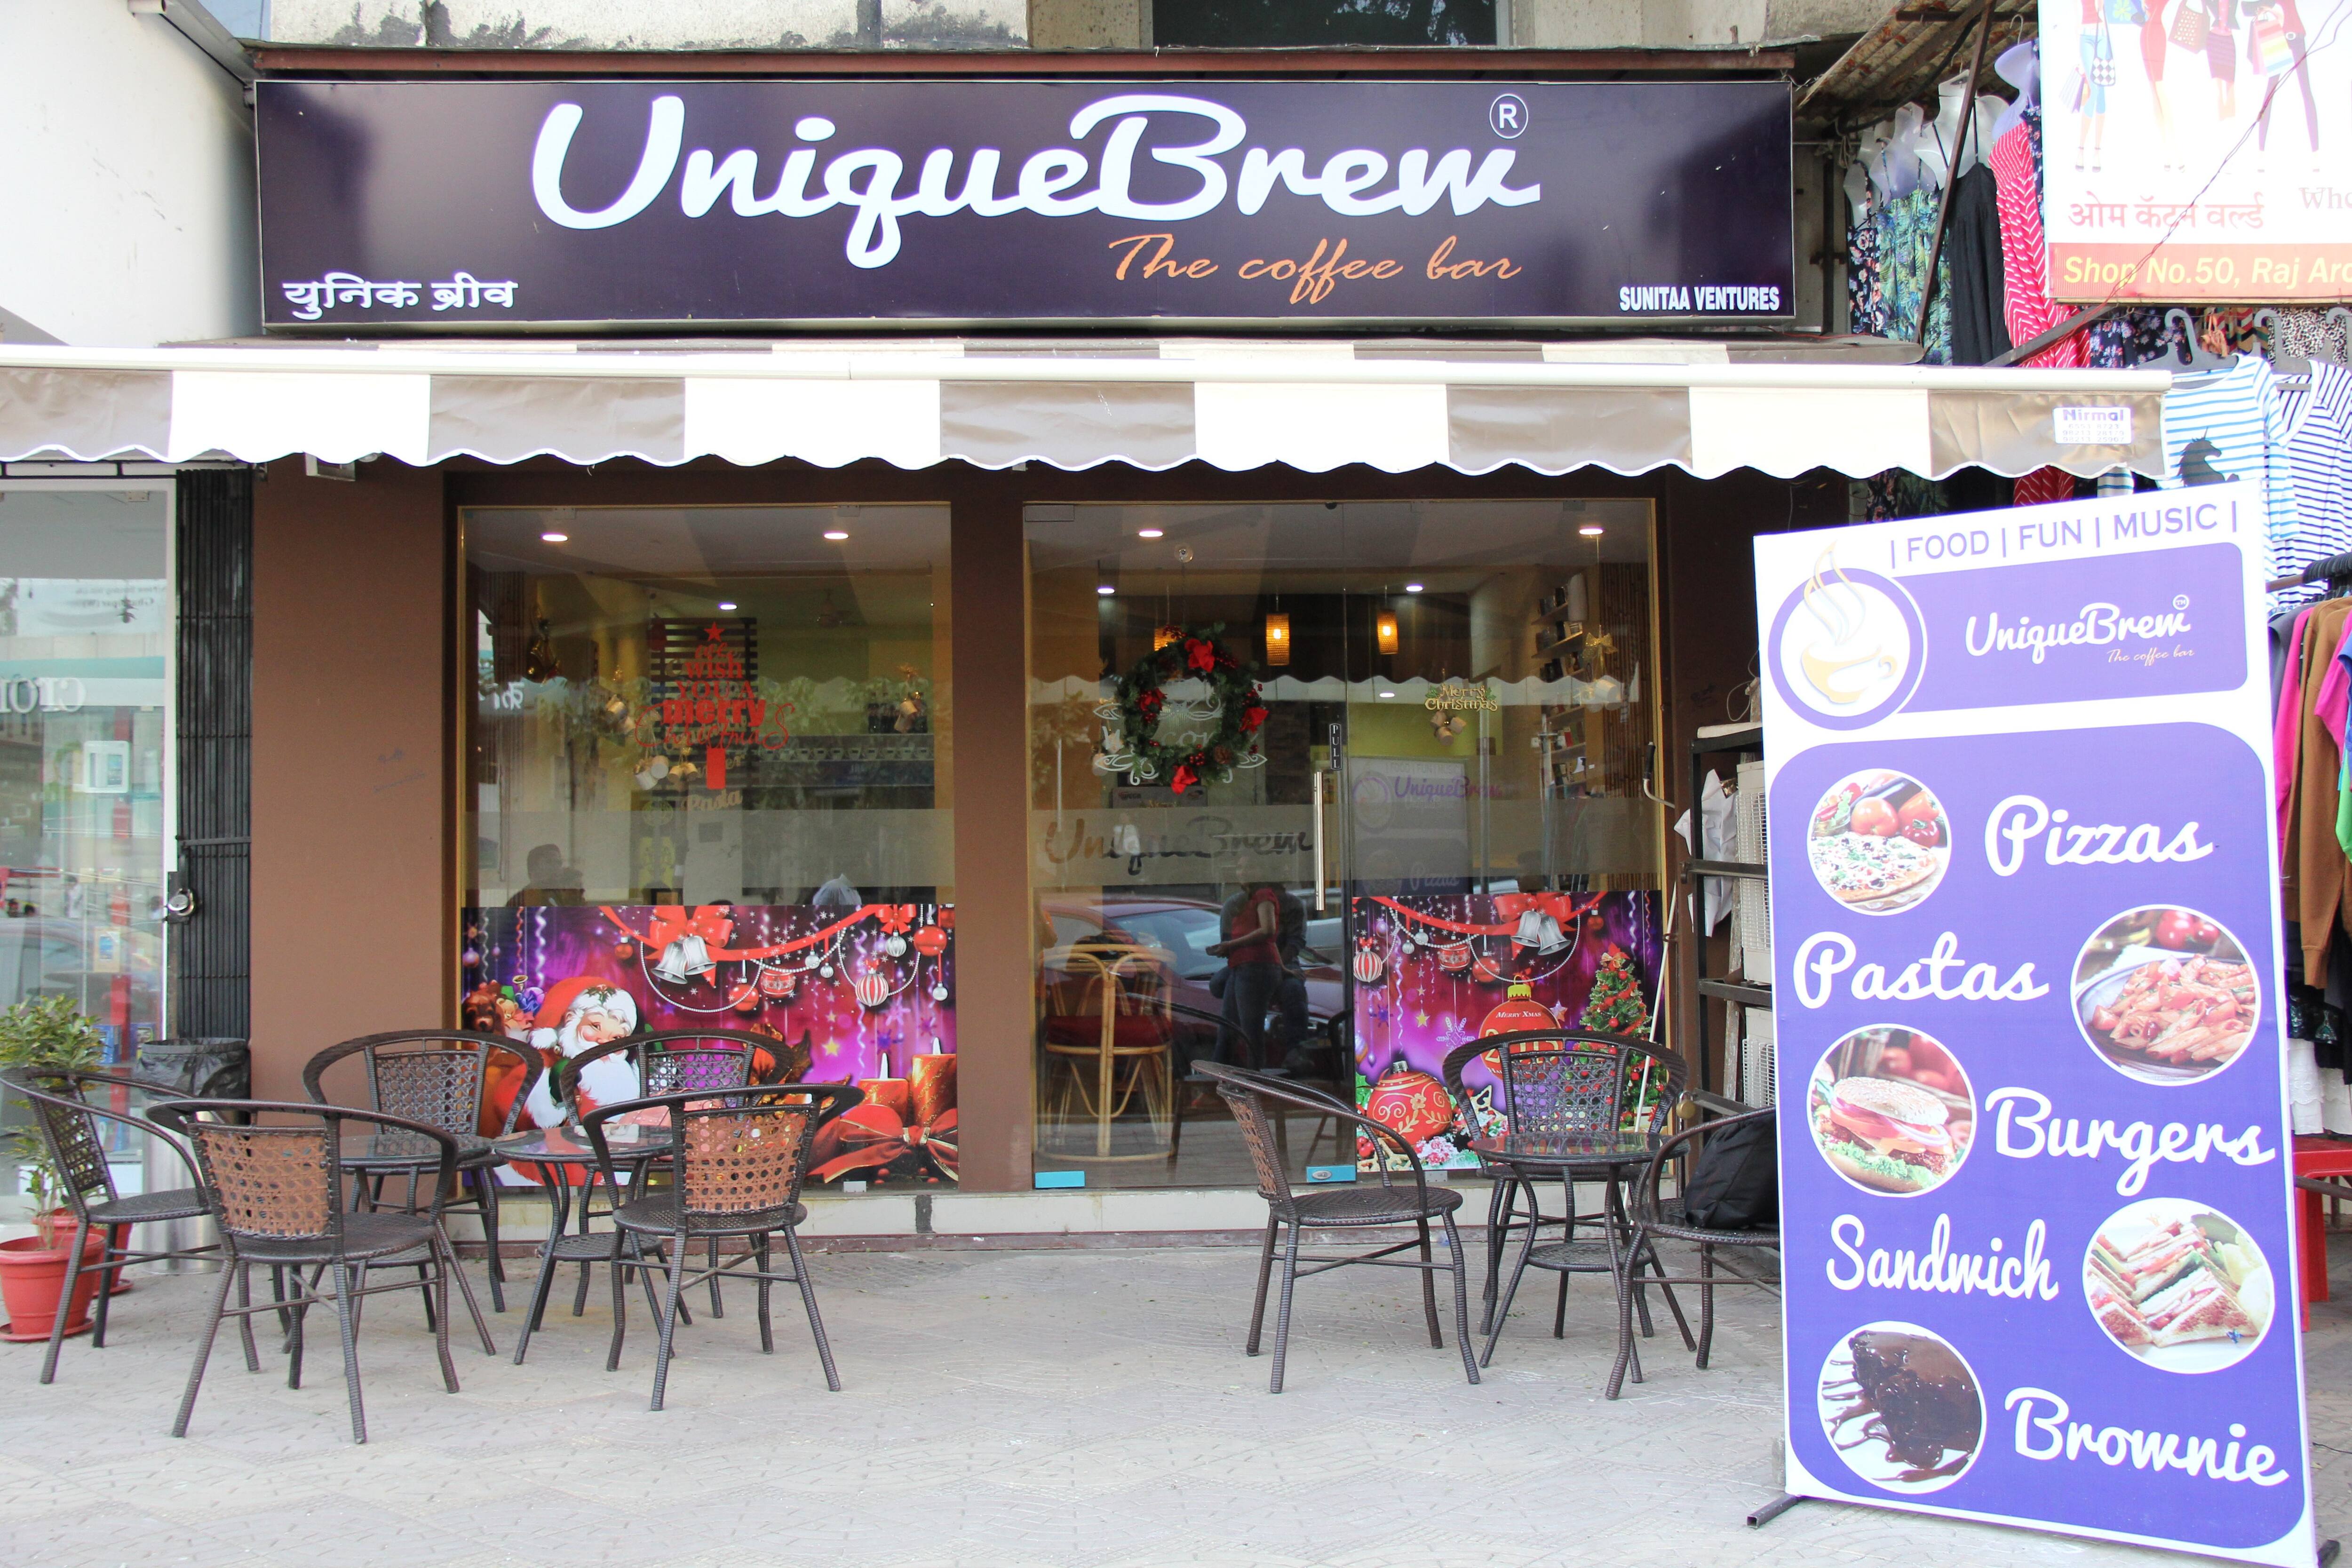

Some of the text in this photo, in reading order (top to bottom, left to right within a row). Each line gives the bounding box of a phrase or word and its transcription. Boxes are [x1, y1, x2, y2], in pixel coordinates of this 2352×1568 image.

[532, 93, 1541, 269] UniqueBrew
[2068, 191, 2127, 229] ओम
[2204, 191, 2266, 229] वर्ल्ड
[1109, 233, 1522, 304] The coffee bar
[2064, 256, 2138, 289] Shop
[2251, 257, 2300, 290] Raj
[281, 271, 519, 320] युनिक ब्रीव
[1619, 286, 1780, 311] SUNITAA VENTURES
[2063, 409, 2124, 421] Nirmal
[1907, 530, 1990, 562] FOOD
[2019, 519, 2082, 550] FUN
[2114, 503, 2217, 540] MUSIC
[1965, 602, 2191, 664] UniqueBrew
[2106, 644, 2195, 667] The coffee bar
[660, 699, 766, 727] merry
[674, 680, 756, 700] YOU A
[1424, 697, 1498, 712] Christmas
[1438, 683, 1486, 701] Merry
[1331, 724, 1340, 770] PULL
[1985, 795, 2214, 877] Pizzas
[1792, 931, 2049, 1009] Pastas
[1985, 1086, 2275, 1196] Burgers
[1825, 1213, 2059, 1300] Sandwich
[2004, 1387, 2289, 1487] Brownie
